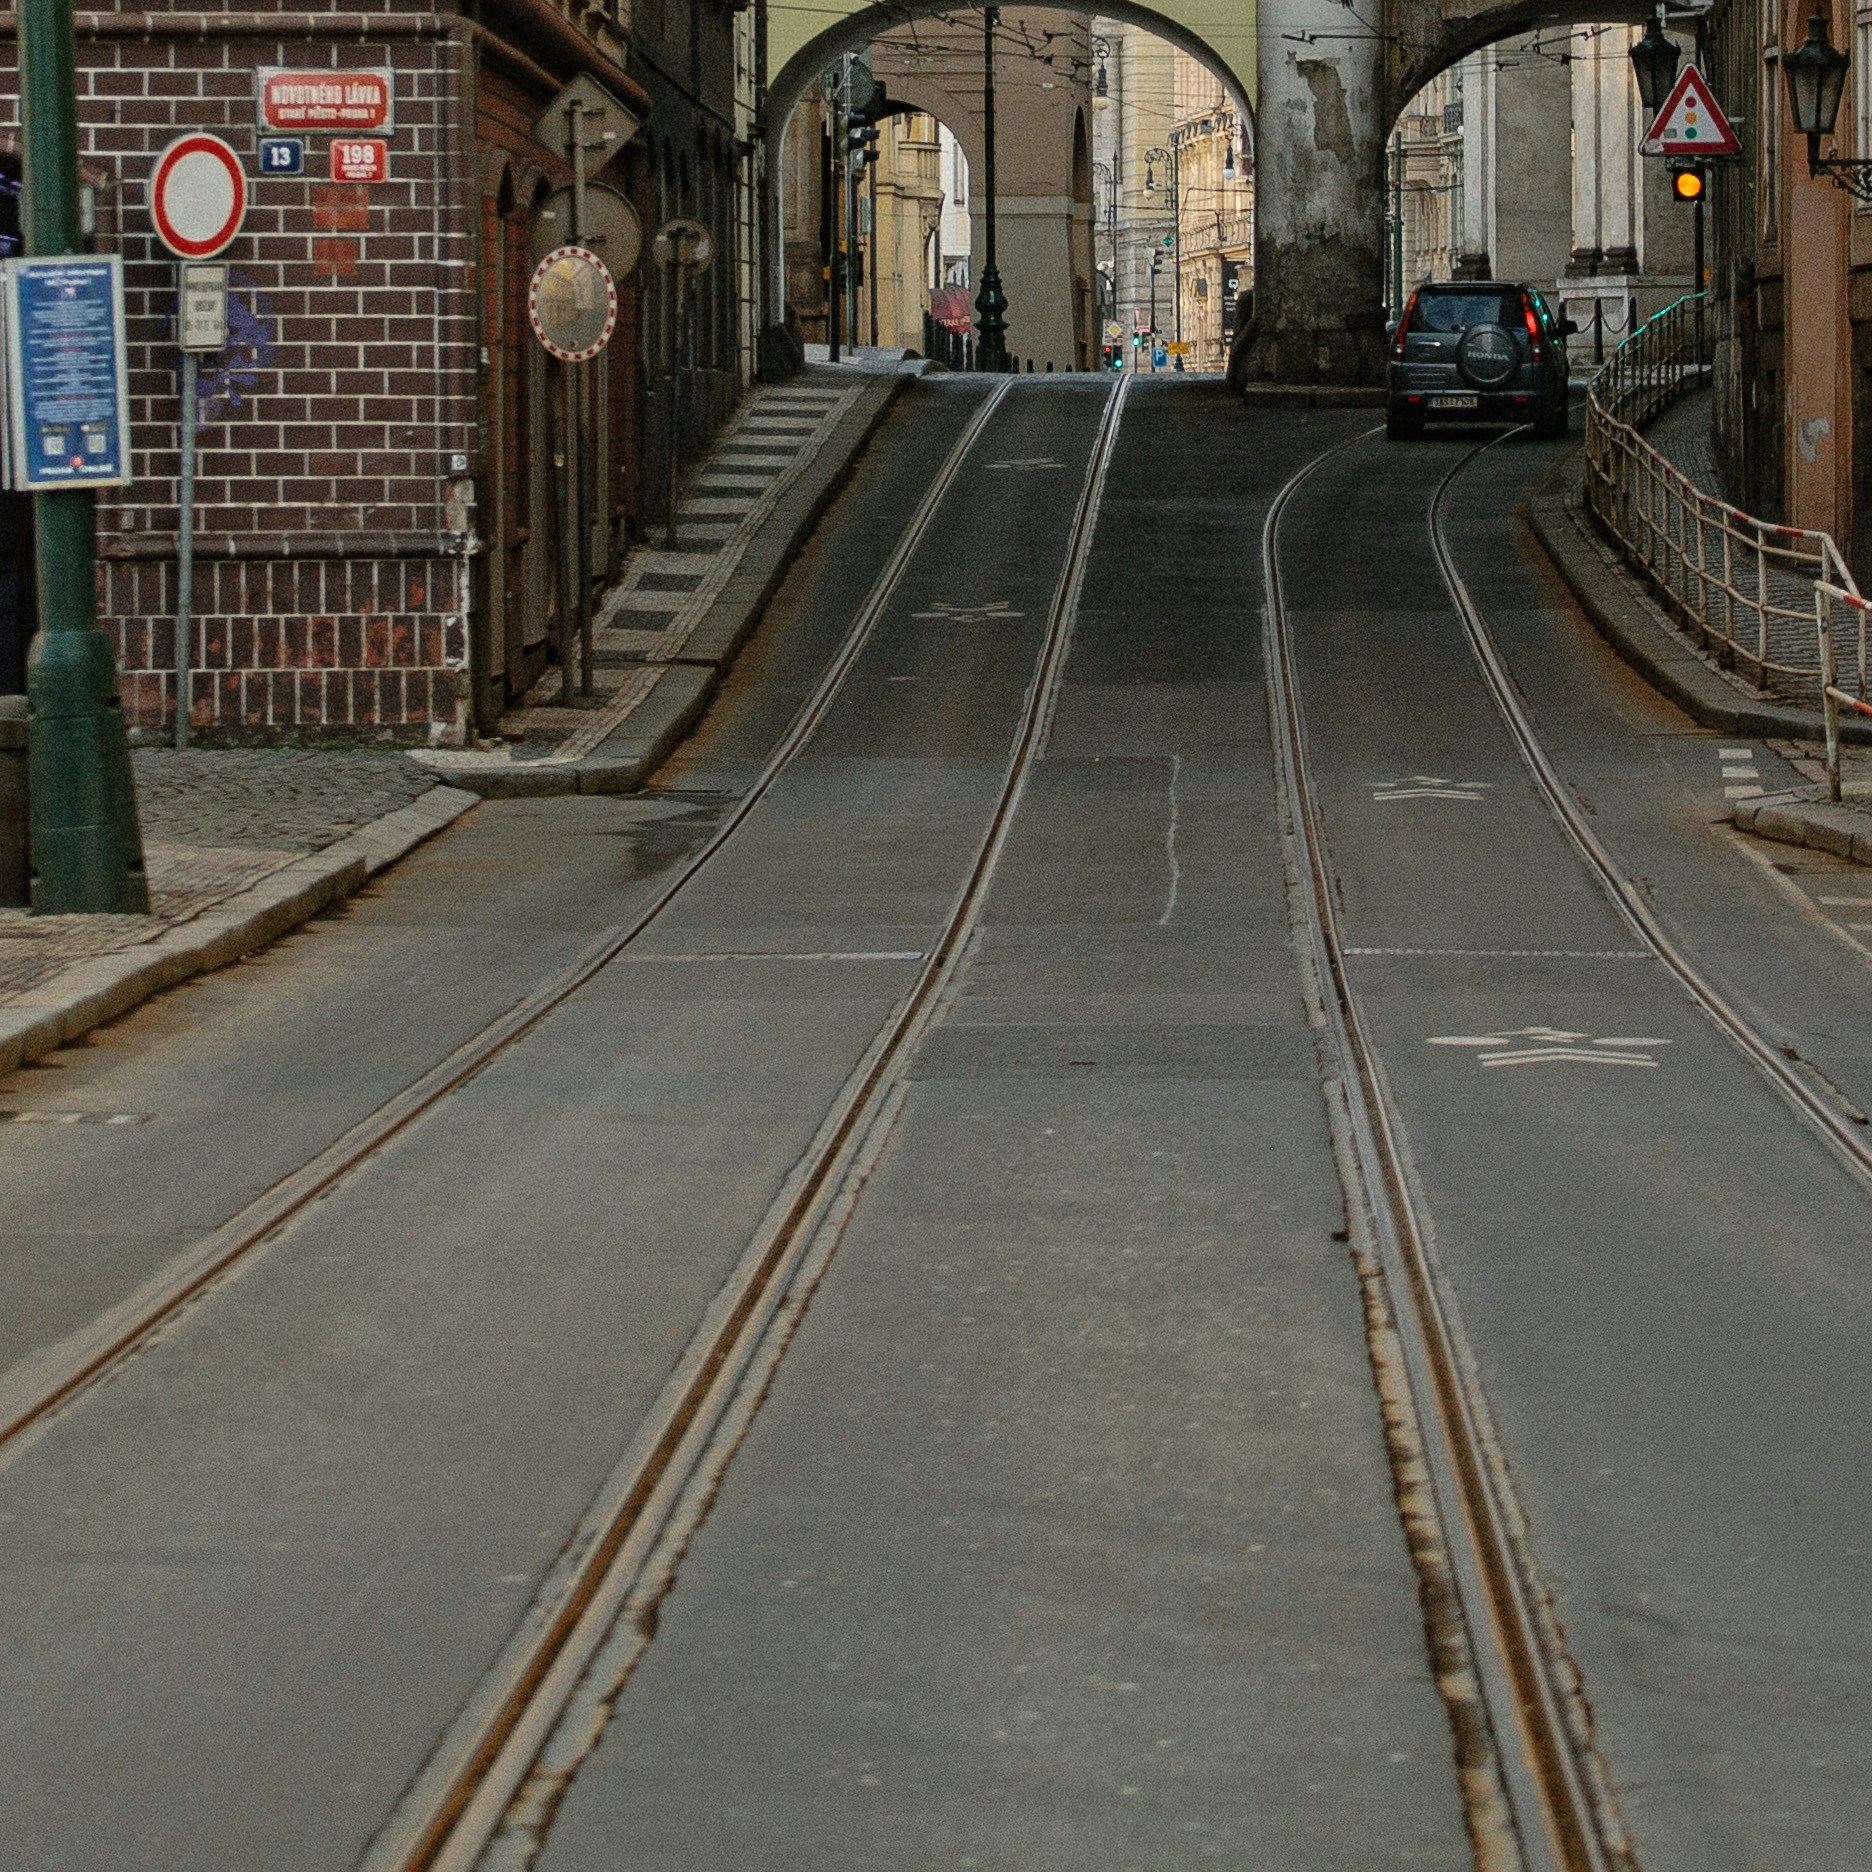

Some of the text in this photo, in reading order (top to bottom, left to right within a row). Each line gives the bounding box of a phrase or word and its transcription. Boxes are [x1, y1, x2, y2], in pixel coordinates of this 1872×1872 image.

[271, 146, 291, 166] 13
[342, 144, 375, 164] 198
[1467, 350, 1510, 361] HONDA
